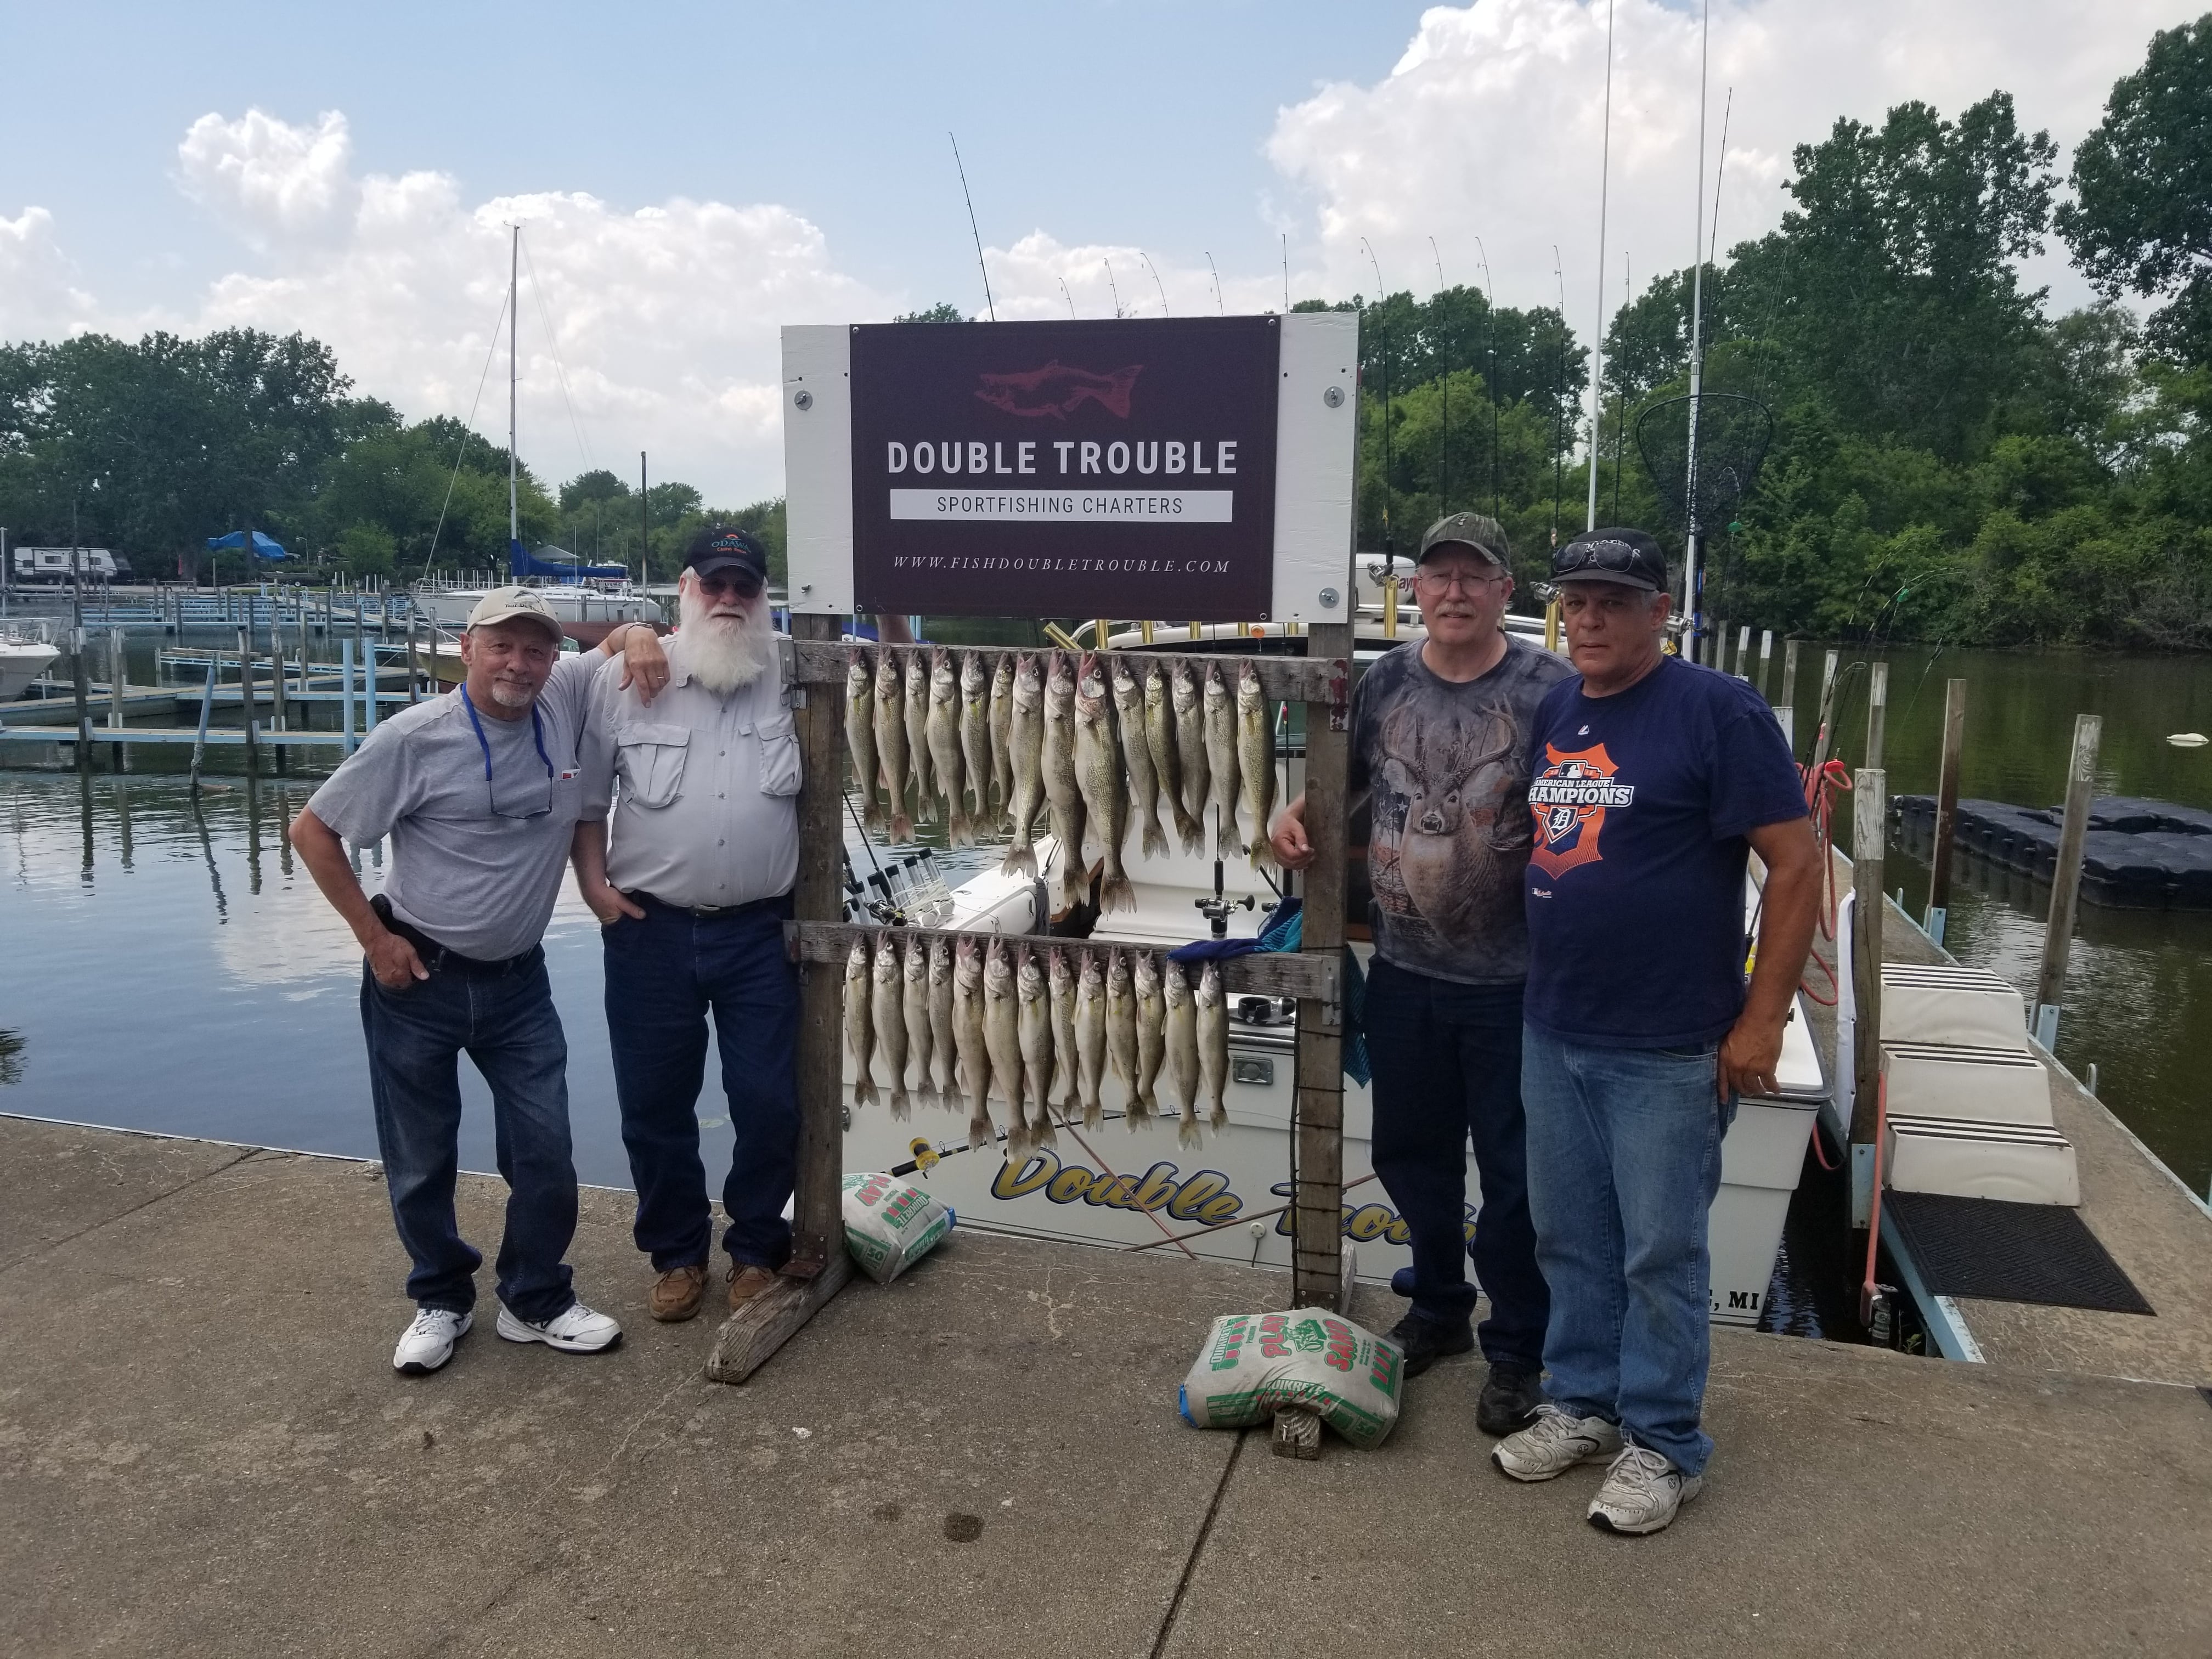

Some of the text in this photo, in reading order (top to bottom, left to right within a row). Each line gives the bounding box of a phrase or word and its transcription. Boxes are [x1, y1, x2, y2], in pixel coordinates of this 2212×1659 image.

[888, 441, 1238, 475] DOUBLE TROUBLE
[937, 496, 1183, 514] SPORTFISHING CHARTERS
[712, 540, 751, 553] ODAWA
[894, 555, 1230, 573] WWW.FISHDOUBLETROUBLE.COM
[1534, 778, 1574, 787] AMERICAN
[1528, 787, 1630, 804] HAMPIONS
[991, 1147, 1243, 1226] Double
[896, 1195, 929, 1227] QUIKRETE
[1728, 1291, 1759, 1310] MI
[1259, 1315, 1292, 1358] PLAY
[1323, 1318, 1358, 1372] SAND
